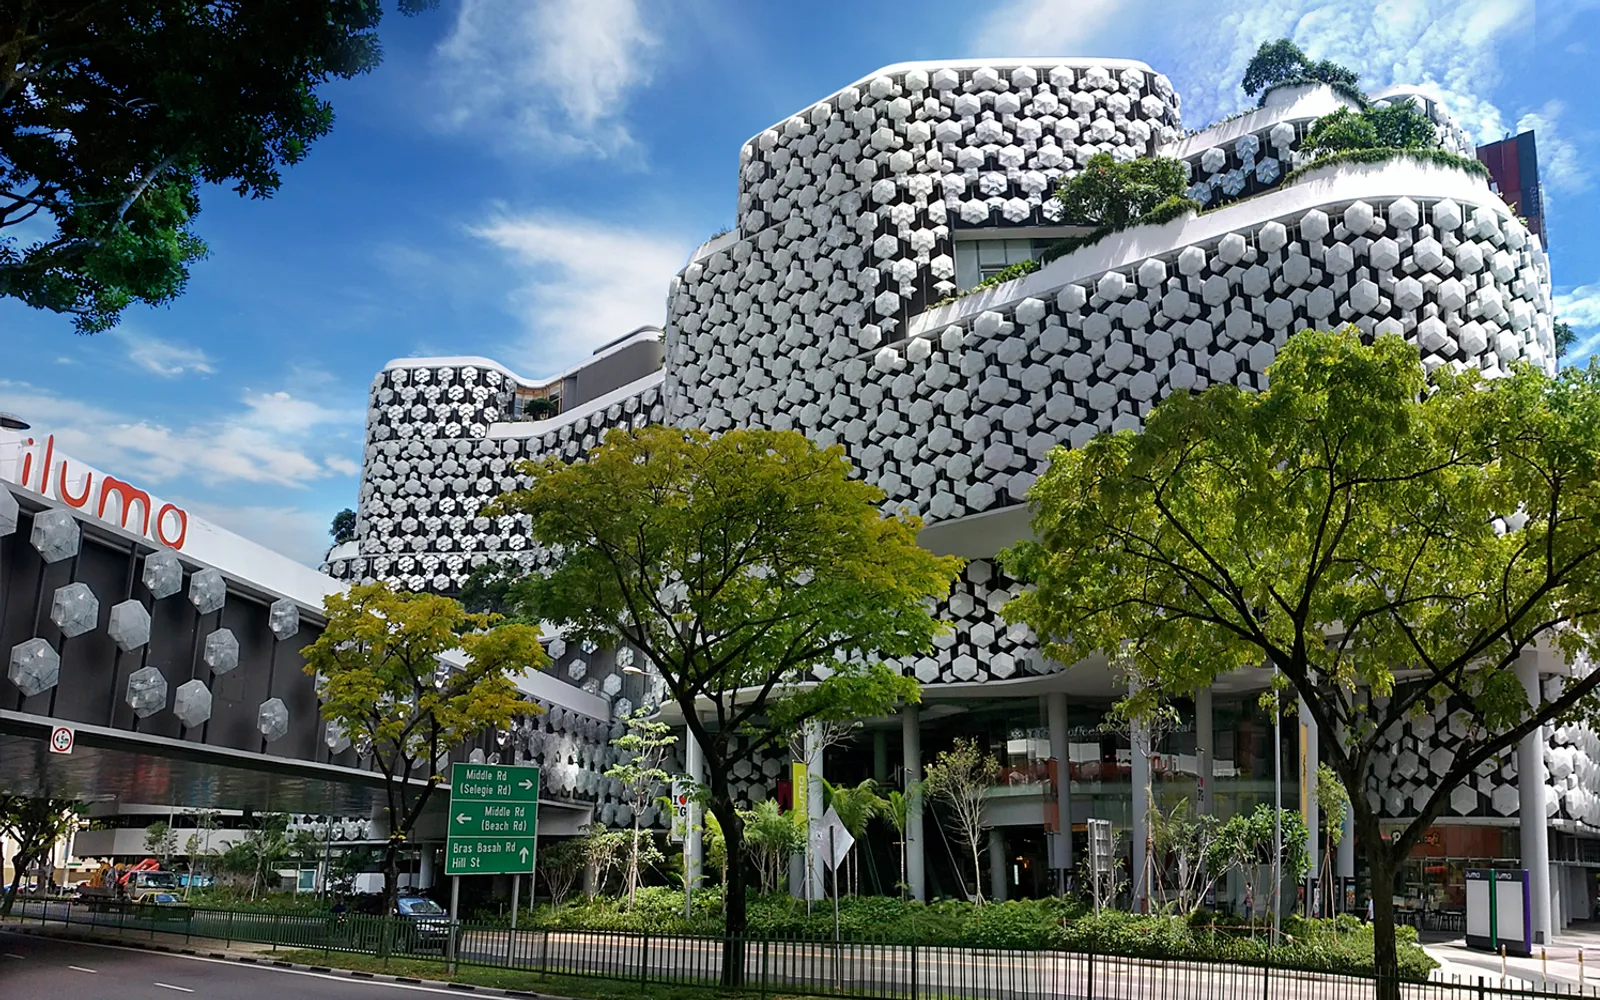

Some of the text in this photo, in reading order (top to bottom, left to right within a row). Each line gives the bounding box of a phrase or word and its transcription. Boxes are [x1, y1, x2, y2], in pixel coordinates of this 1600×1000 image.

[20, 434, 187, 550] iluma
[466, 769, 507, 780] Middle Rd
[460, 783, 512, 796] (Selegie Rd)
[484, 806, 525, 816] Middle Rd
[482, 820, 526, 831] (Beach Rd)
[453, 842, 516, 854] Bras Basah Rd
[452, 857, 480, 868] Hill St
